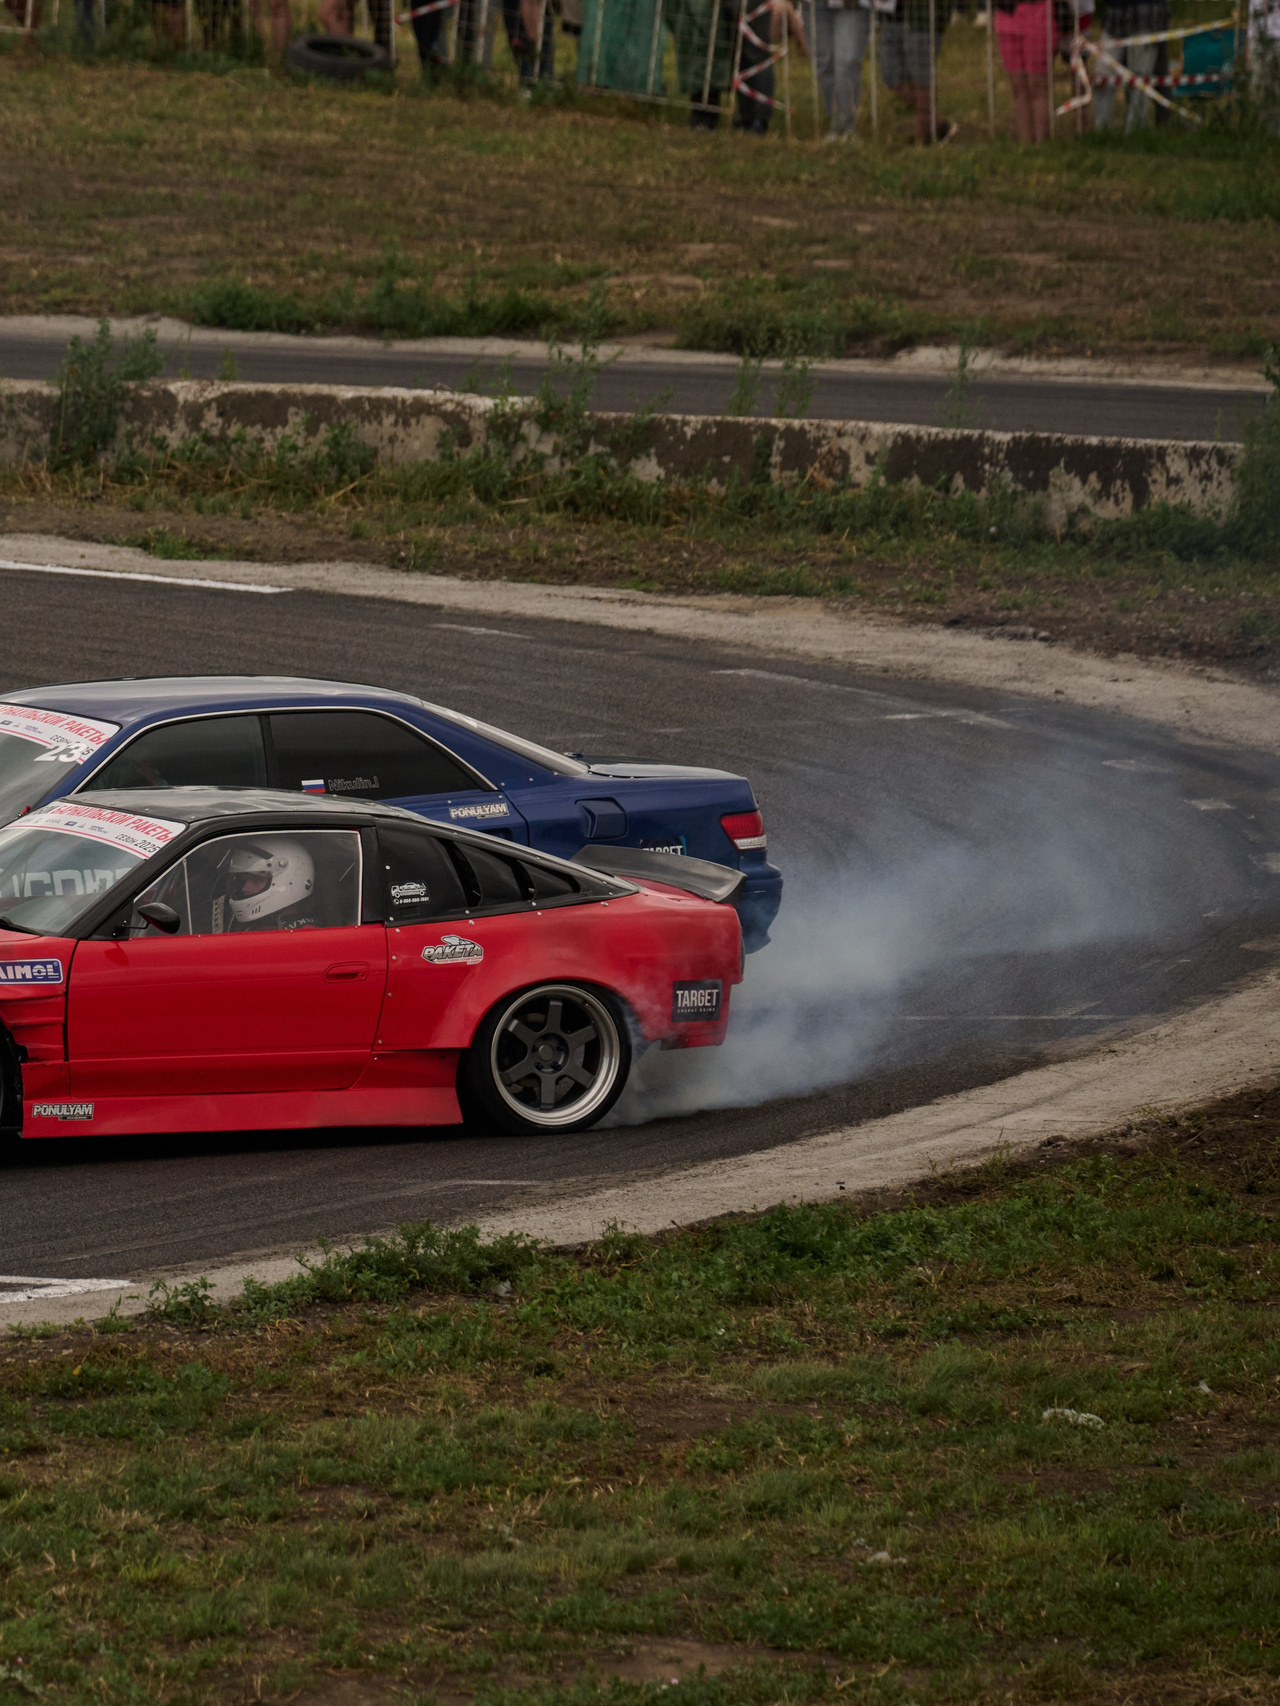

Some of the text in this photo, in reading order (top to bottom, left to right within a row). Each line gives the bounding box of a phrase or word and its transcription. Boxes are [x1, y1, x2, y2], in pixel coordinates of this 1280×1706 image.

[33, 741, 87, 763] 23
[450, 803, 507, 818] PONULYAM
[115, 833, 160, 853] СЕЗОН 2025
[22, 867, 133, 897] СОЮ
[676, 989, 719, 1007] TARGET
[32, 1103, 94, 1117] PONULYAM
